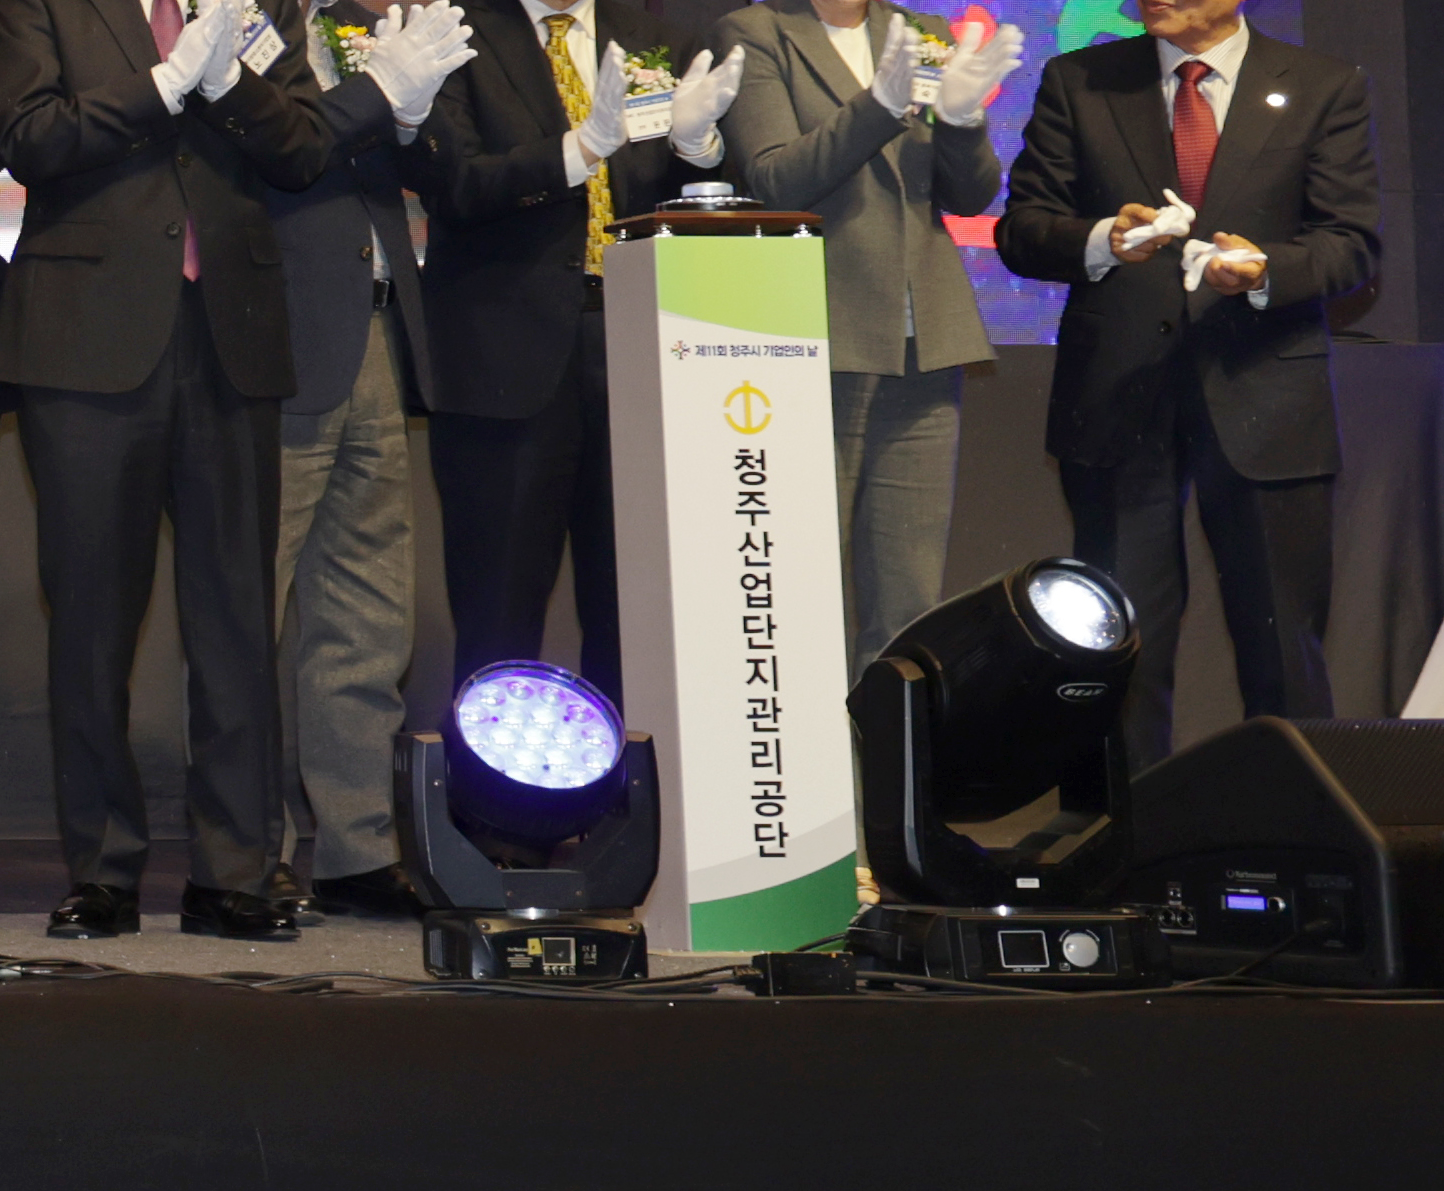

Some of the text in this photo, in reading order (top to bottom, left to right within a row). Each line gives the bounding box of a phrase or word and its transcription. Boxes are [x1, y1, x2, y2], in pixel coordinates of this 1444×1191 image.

[695, 345, 819, 358] 제11회 청주시 기업인의 날
[734, 448, 789, 858] 청주산업단지관리공단
